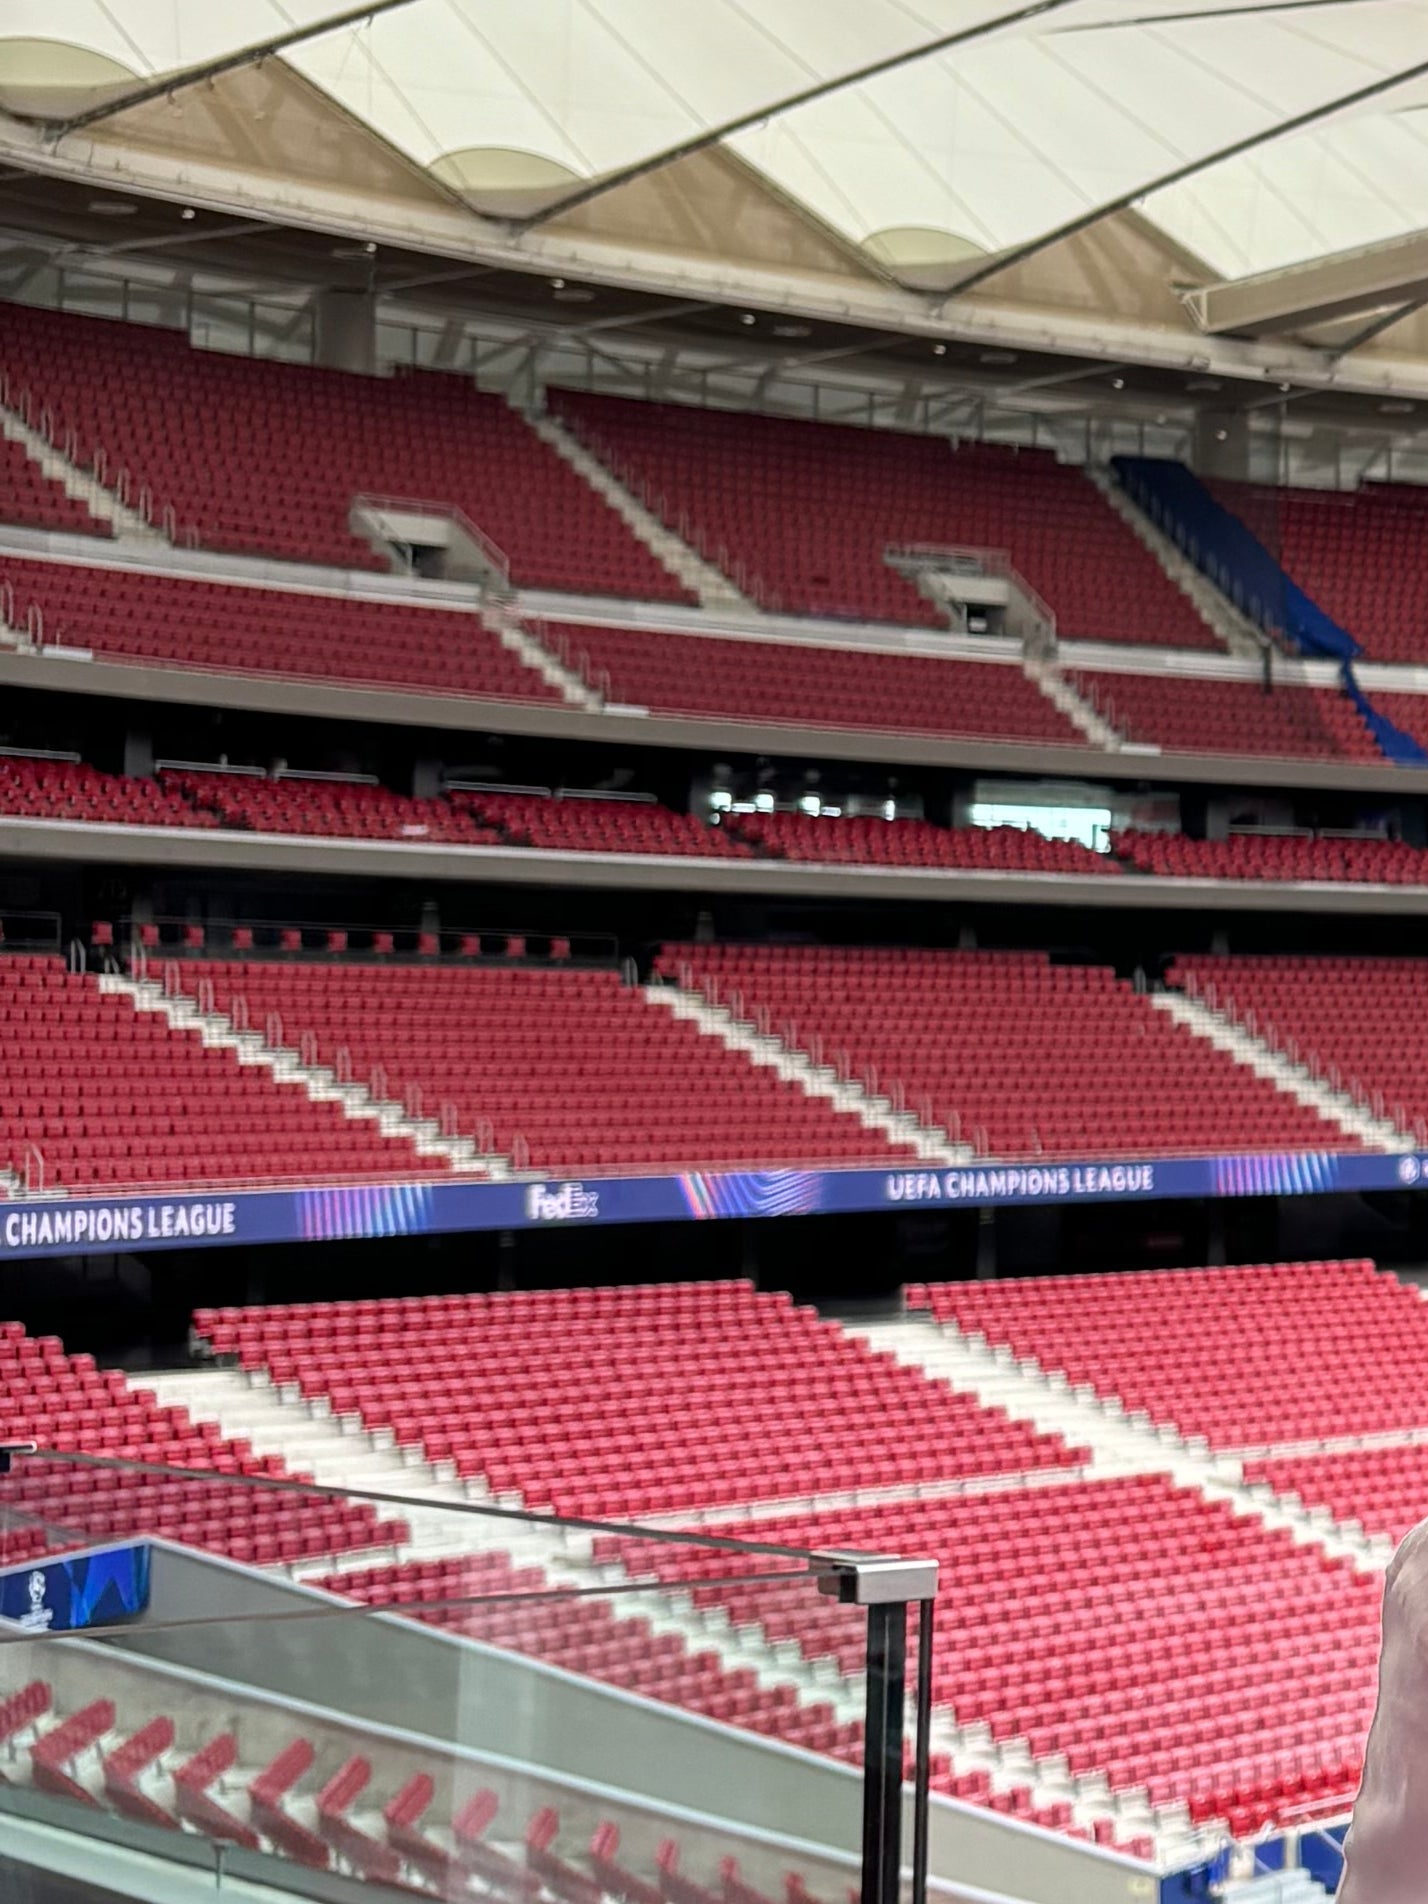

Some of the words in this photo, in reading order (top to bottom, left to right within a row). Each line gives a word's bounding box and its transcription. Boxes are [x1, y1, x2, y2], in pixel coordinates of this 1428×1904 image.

[529, 1182, 600, 1220] FedEx
[887, 1173, 941, 1202] UEFA
[945, 1167, 1070, 1199] CHAMPIONS
[1073, 1165, 1155, 1194] LEAGUE
[5, 1205, 143, 1246] CHAMPIONS
[148, 1202, 236, 1238] LEAGUE
